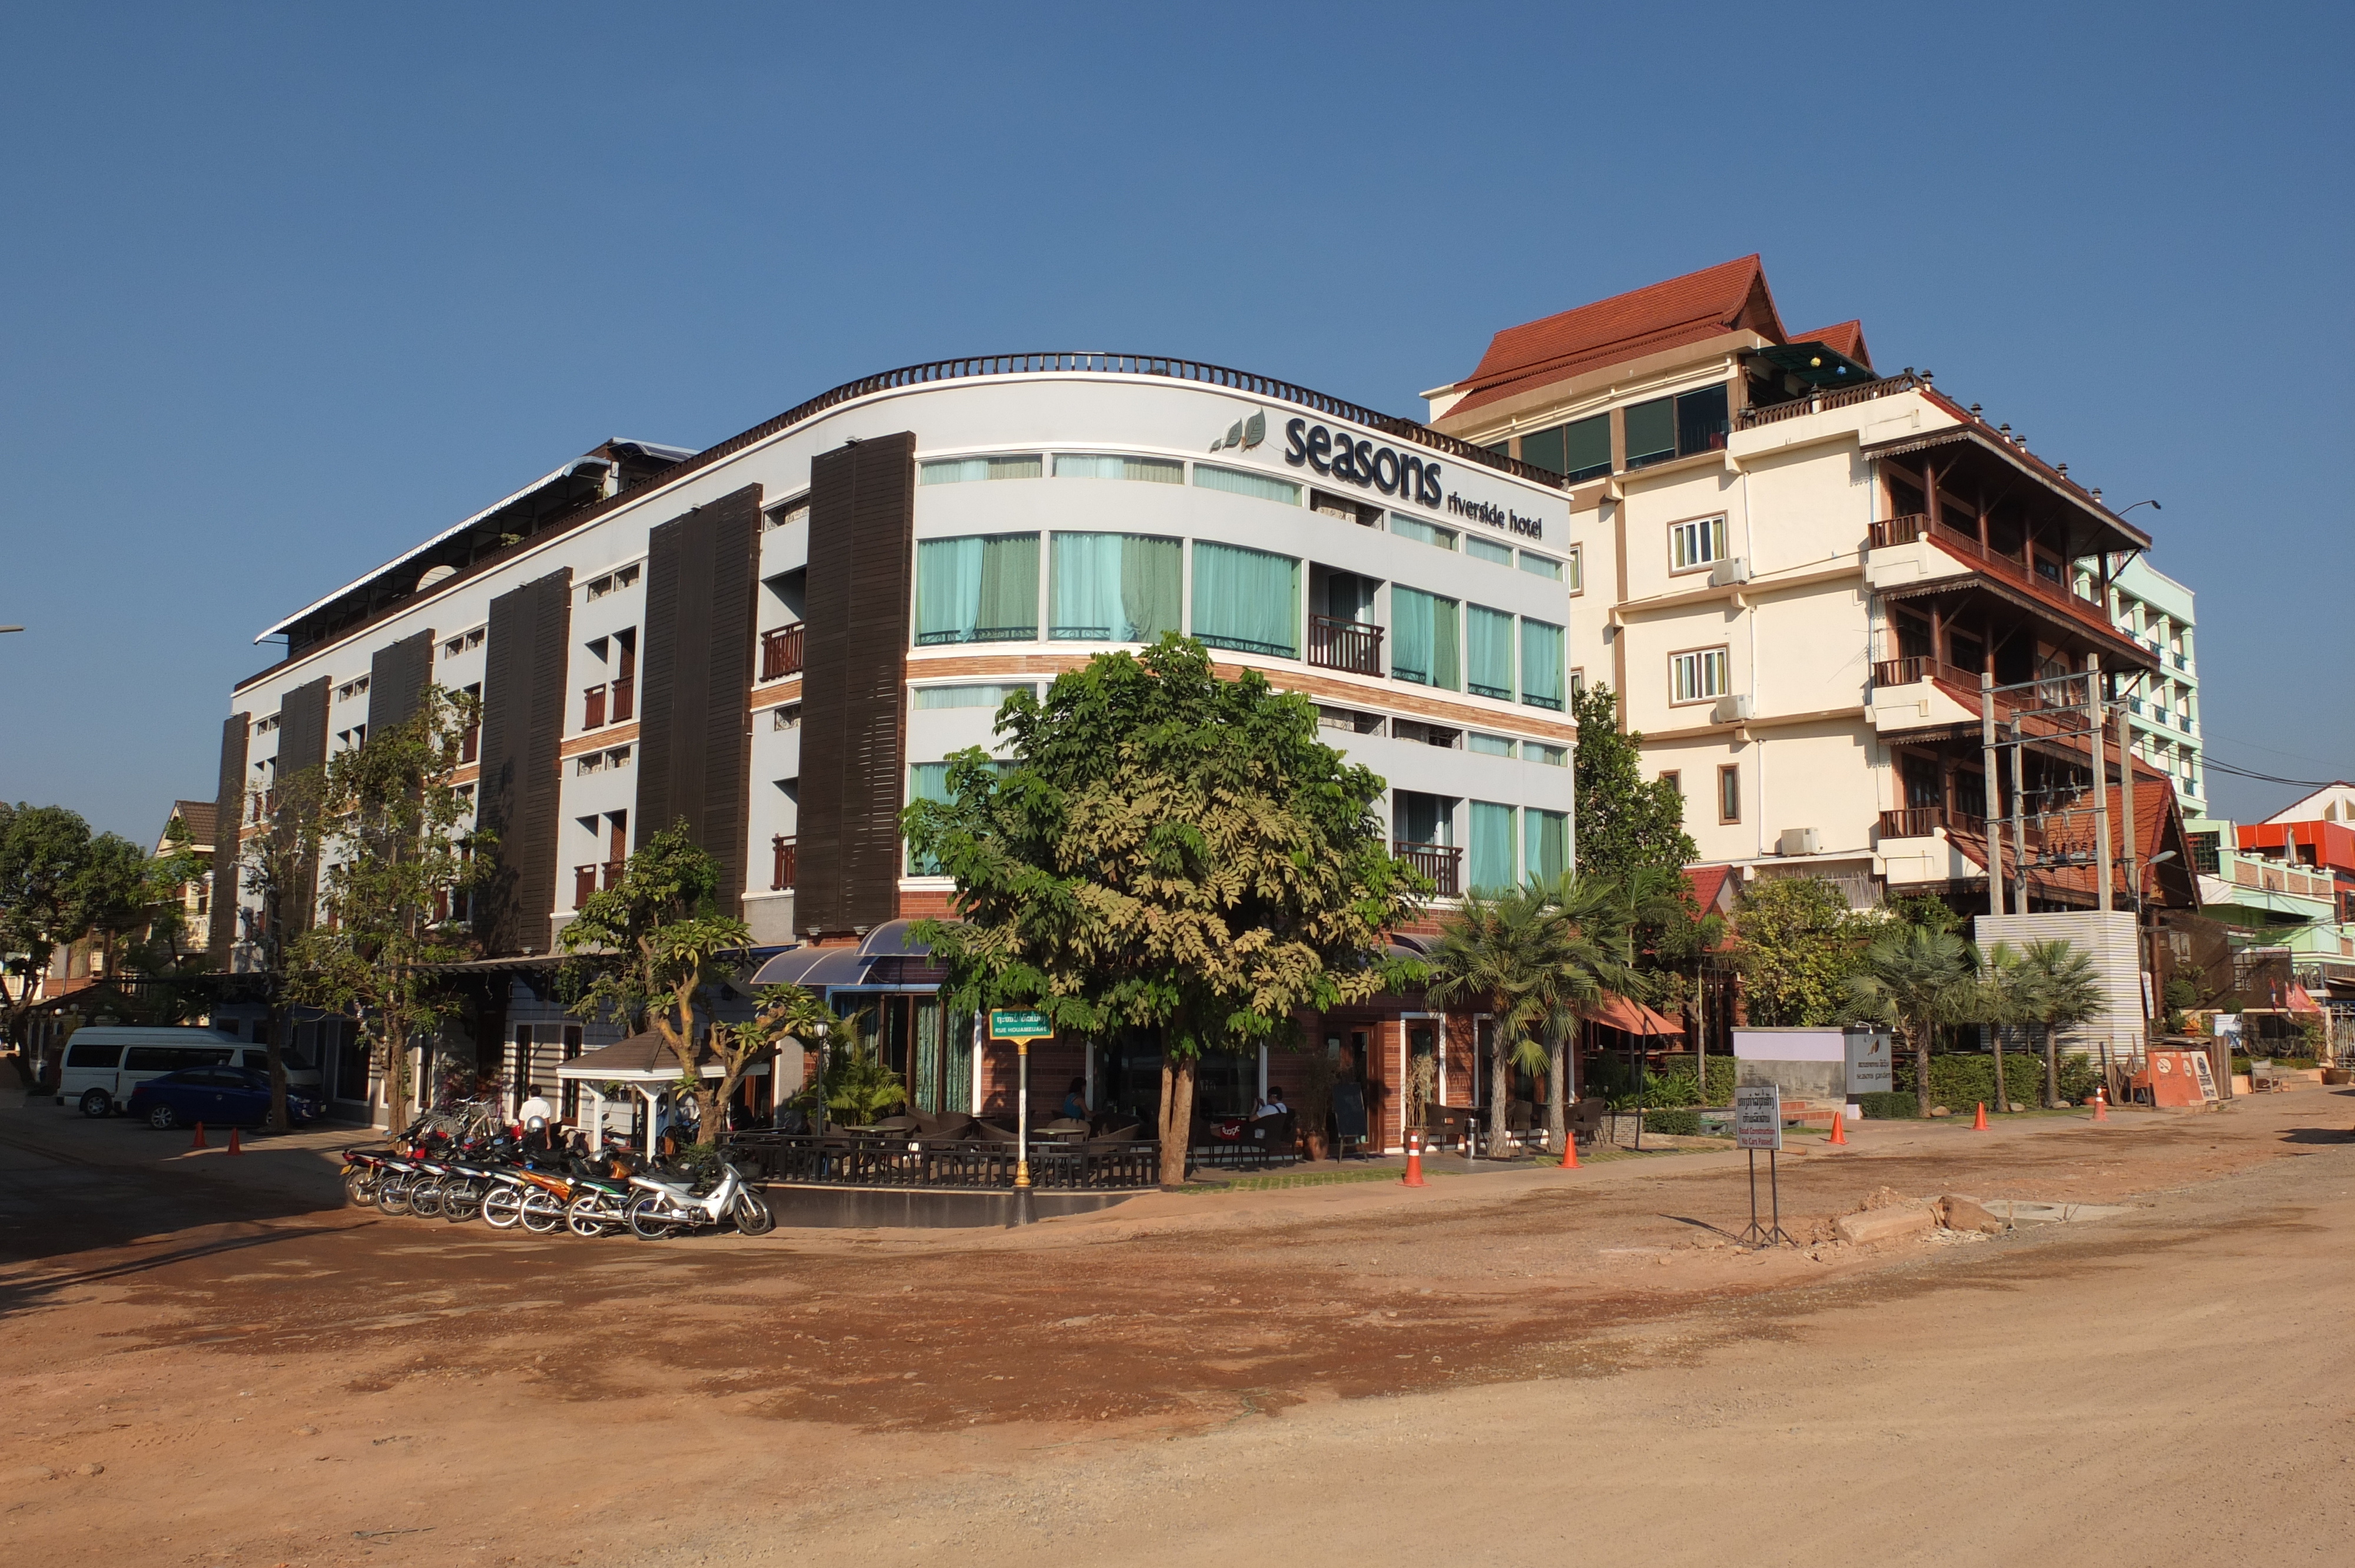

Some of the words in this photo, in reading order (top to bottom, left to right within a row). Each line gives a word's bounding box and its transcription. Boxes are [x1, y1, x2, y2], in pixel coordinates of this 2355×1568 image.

[1285, 417, 1442, 506] seasons
[1447, 491, 1505, 529] riverside
[1509, 507, 1543, 540] hotel
[1875, 1072, 1891, 1080] garden
[1750, 1127, 1776, 1135] Construction
